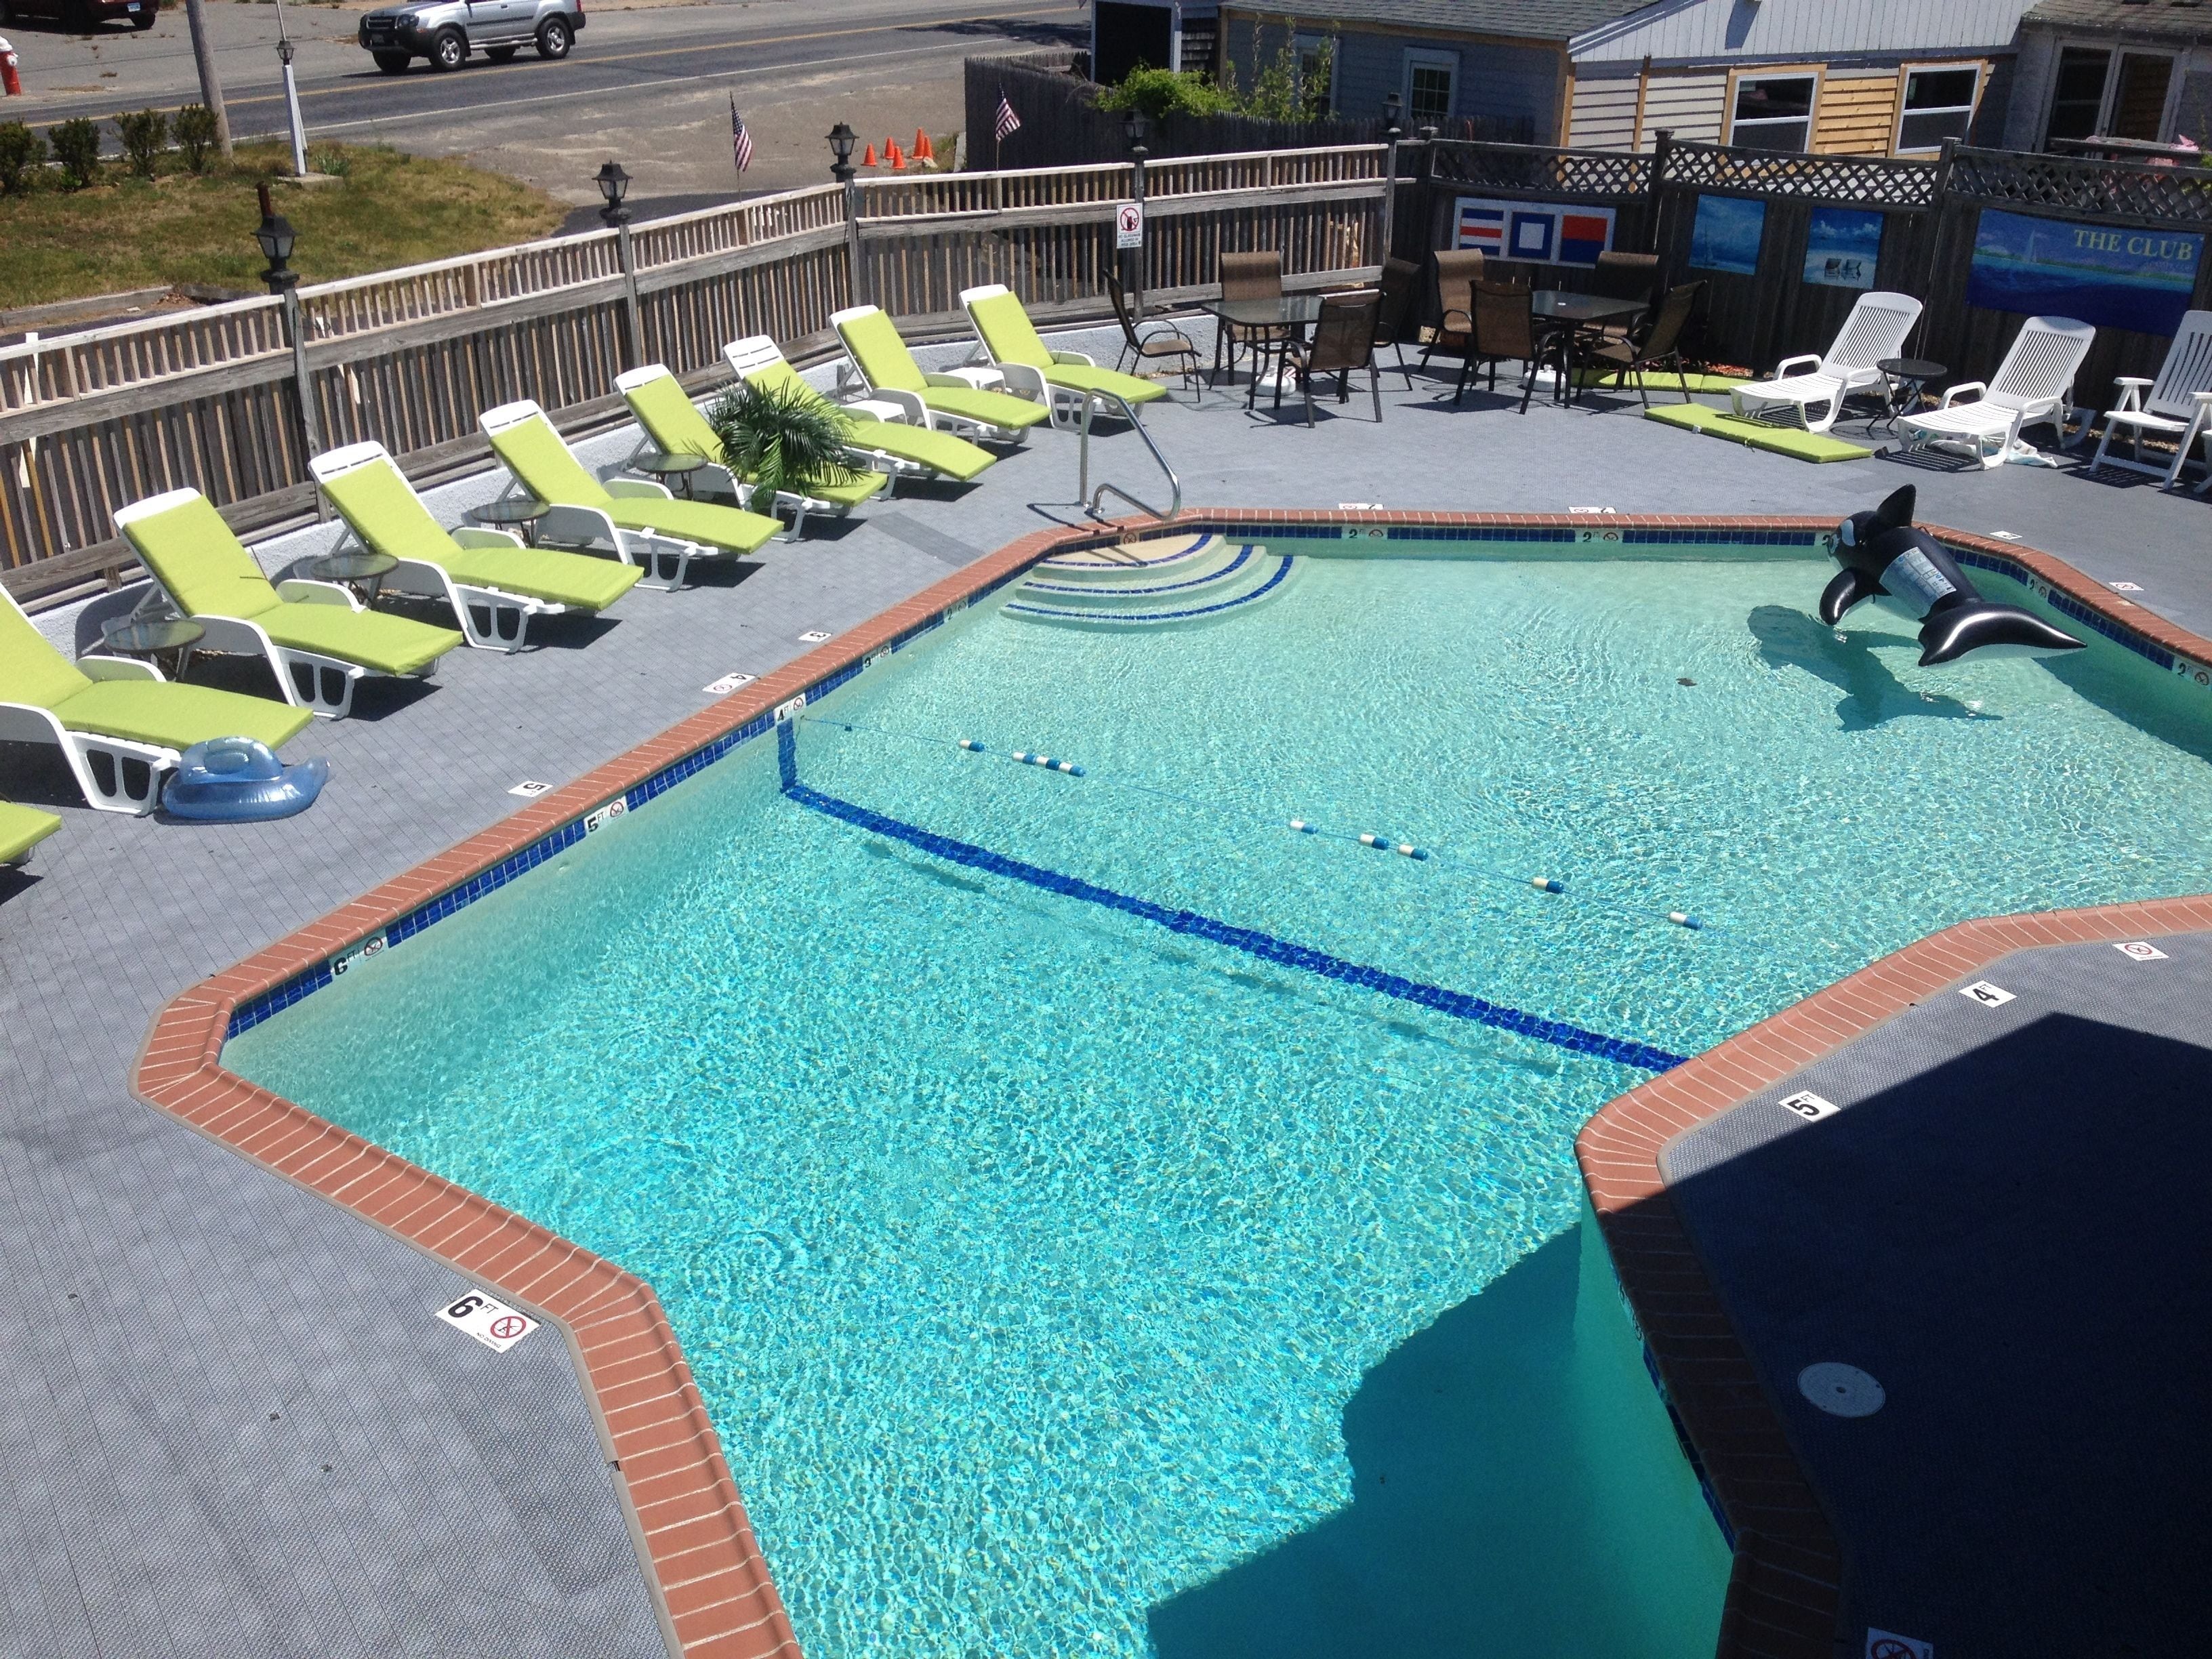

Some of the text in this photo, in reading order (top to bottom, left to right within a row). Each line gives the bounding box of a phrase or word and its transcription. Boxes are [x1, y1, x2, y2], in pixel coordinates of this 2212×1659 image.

[2074, 229, 2193, 260] THE CLUB
[1349, 529, 1357, 538] 2
[1582, 531, 1592, 542] 2
[947, 607, 954, 620] 2
[864, 657, 872, 668] 3
[2177, 663, 2186, 677] 2
[777, 709, 785, 721] 4
[588, 816, 598, 832] 5
[597, 811, 604, 822] FT
[334, 949, 356, 975] 6 FT
[1972, 988, 2000, 1002] 4
[1786, 1094, 1820, 1115] 5 FT
[448, 1296, 499, 1318] 6 FT
